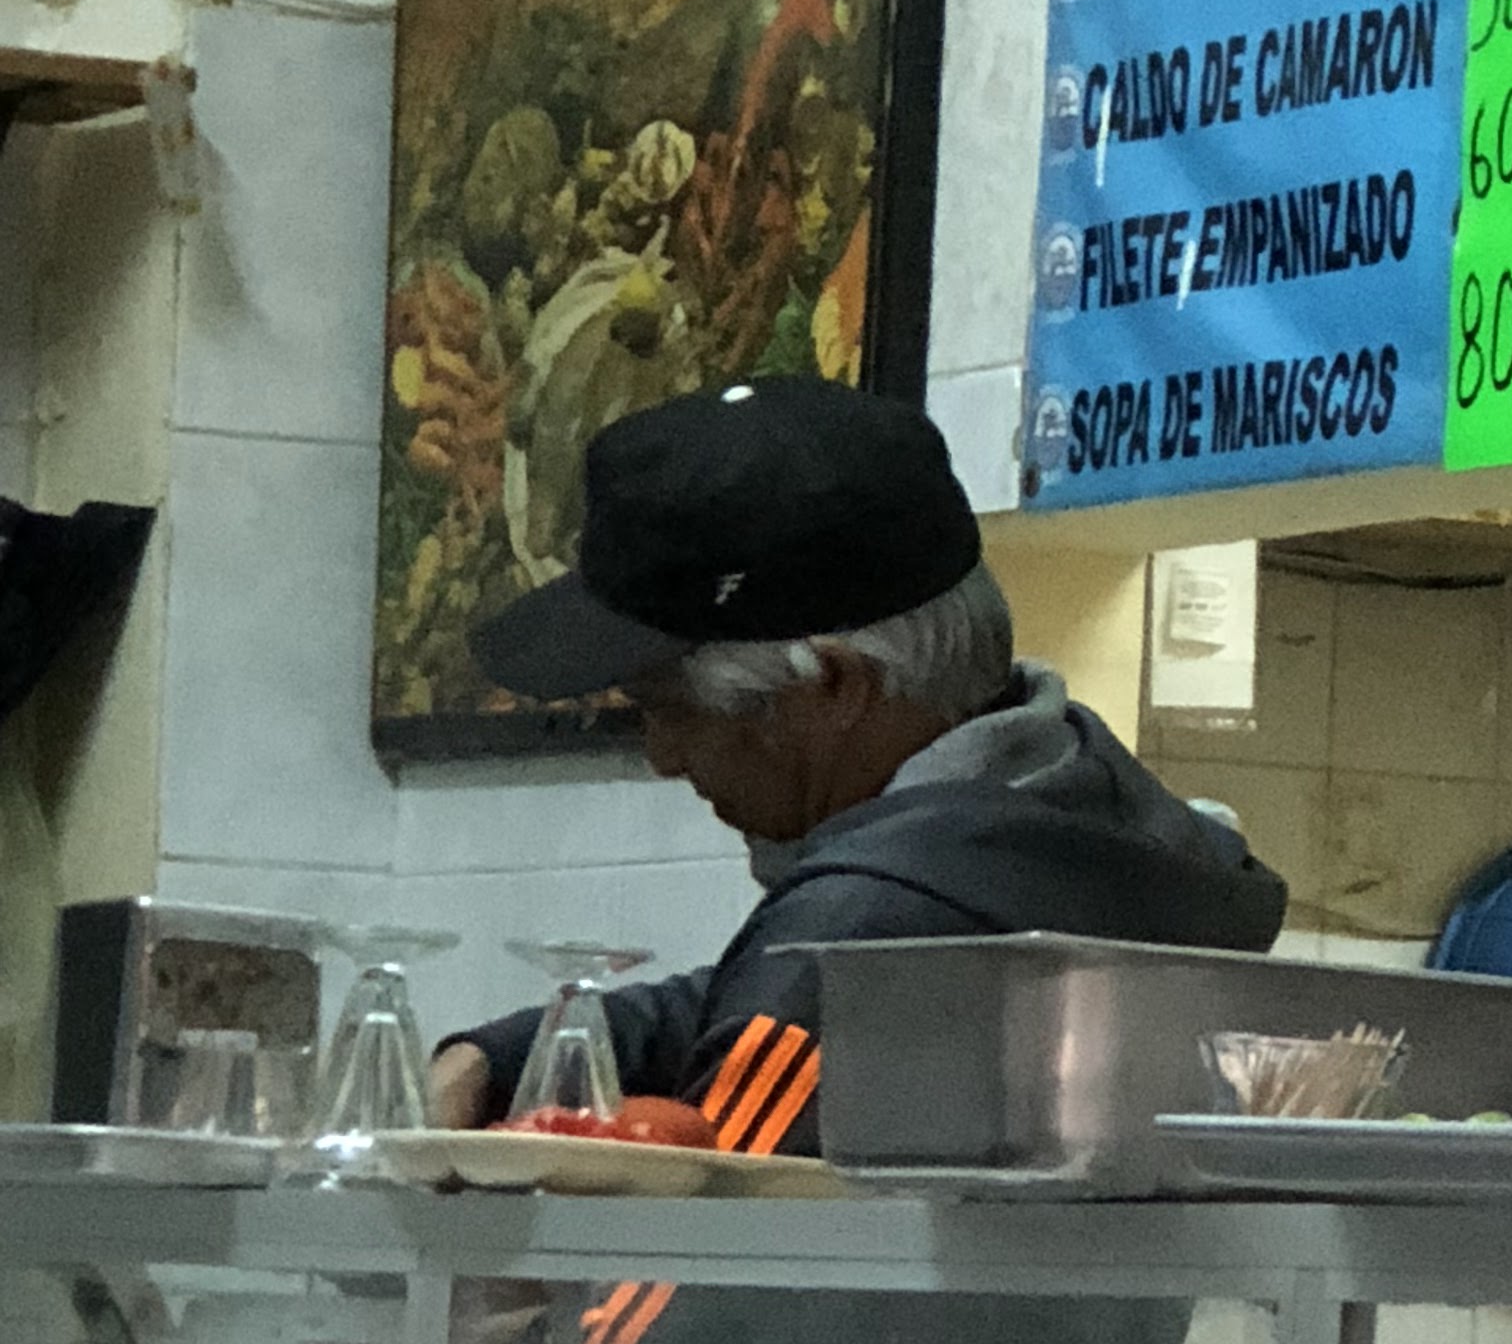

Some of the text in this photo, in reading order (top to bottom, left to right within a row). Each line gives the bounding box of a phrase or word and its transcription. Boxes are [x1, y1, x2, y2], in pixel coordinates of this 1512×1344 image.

[1081, 46, 1190, 150] CALDO
[1199, 34, 1247, 127] DE
[1080, 168, 1416, 312] FILETE EMPANIZADO
[1067, 344, 1398, 474] SOPA DE MARISCOS
